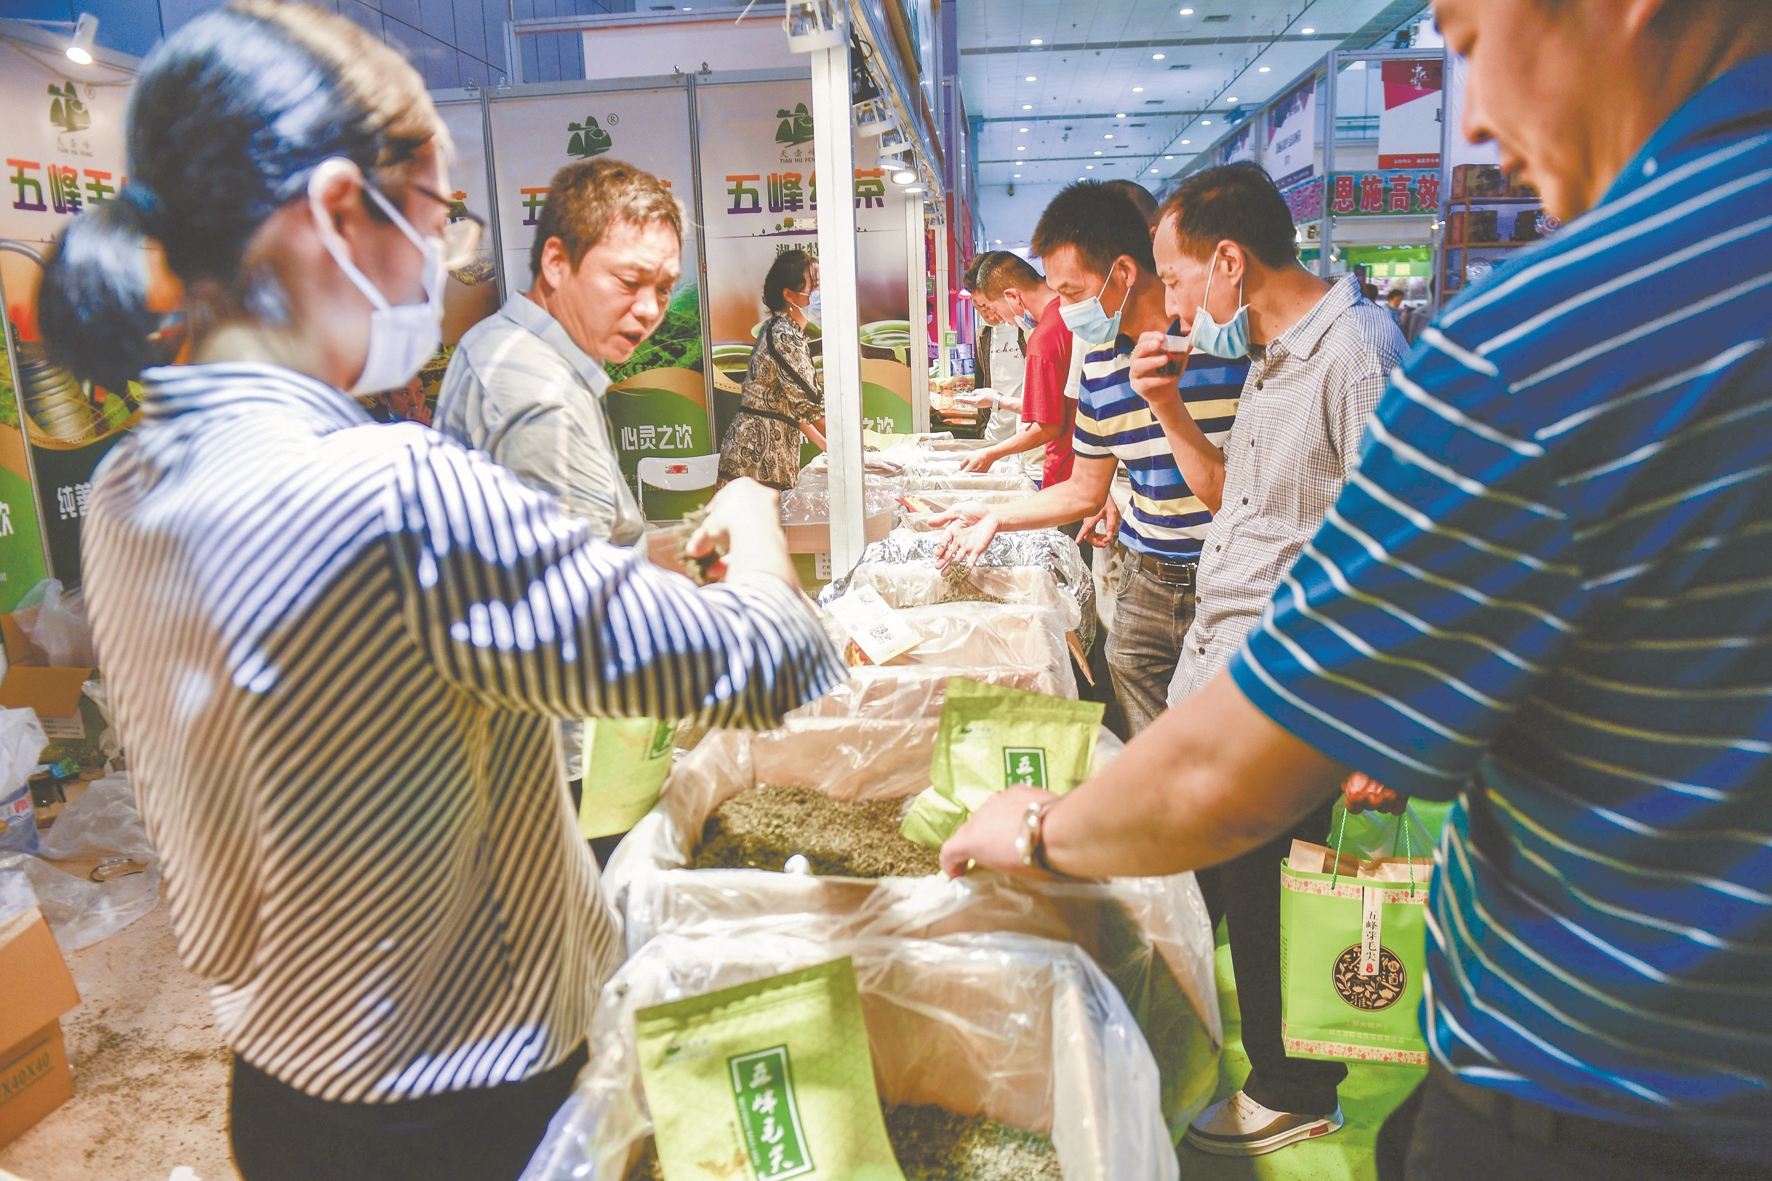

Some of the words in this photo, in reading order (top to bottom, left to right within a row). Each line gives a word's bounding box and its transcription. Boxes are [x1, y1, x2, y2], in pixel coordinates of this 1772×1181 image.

[6, 158, 127, 214] 五峰毛
[725, 168, 886, 215] 五峰茶
[1331, 173, 1440, 213] 恩施高效
[621, 423, 694, 450] 心灵之饮
[1365, 910, 1378, 962] 五峰芽毛尖
